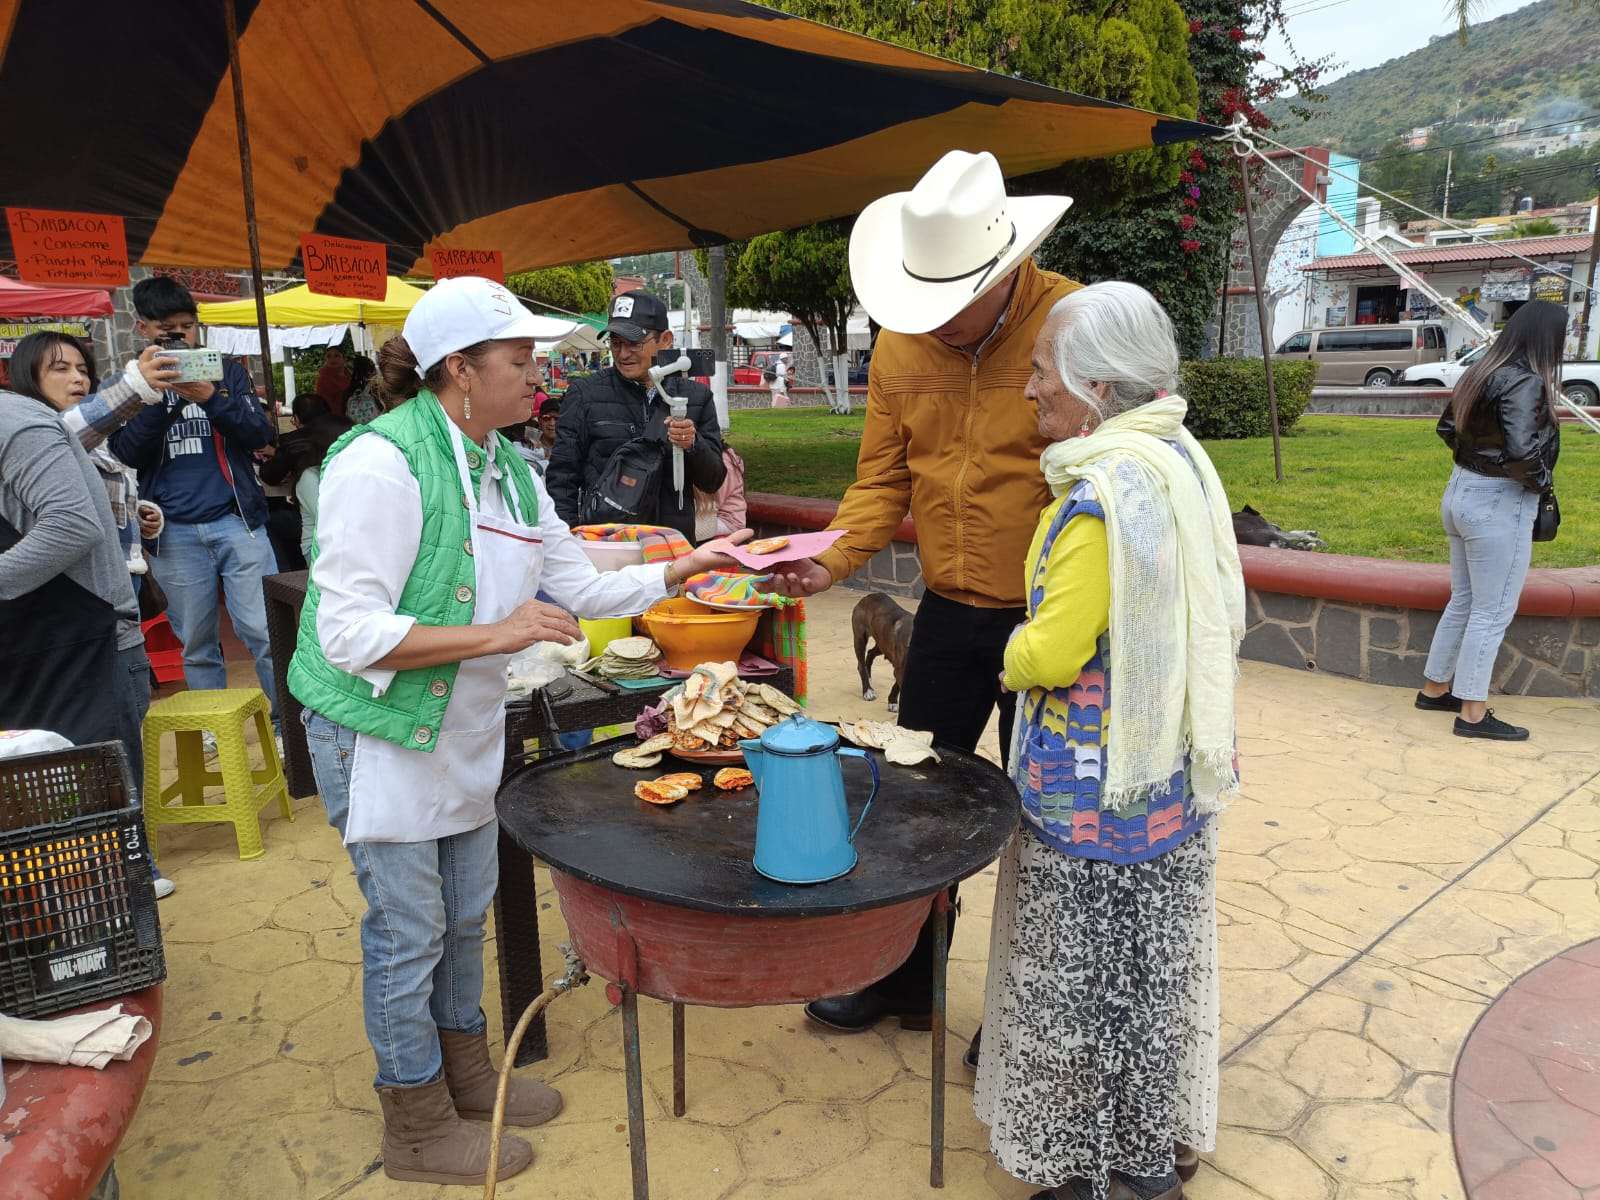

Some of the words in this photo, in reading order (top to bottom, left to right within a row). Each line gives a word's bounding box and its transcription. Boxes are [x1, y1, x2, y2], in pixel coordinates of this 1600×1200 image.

[15, 211, 108, 233] BARBACOA
[306, 245, 381, 276] BARBACOA
[435, 250, 496, 266] BARBACOA
[128, 852, 142, 860] 3
